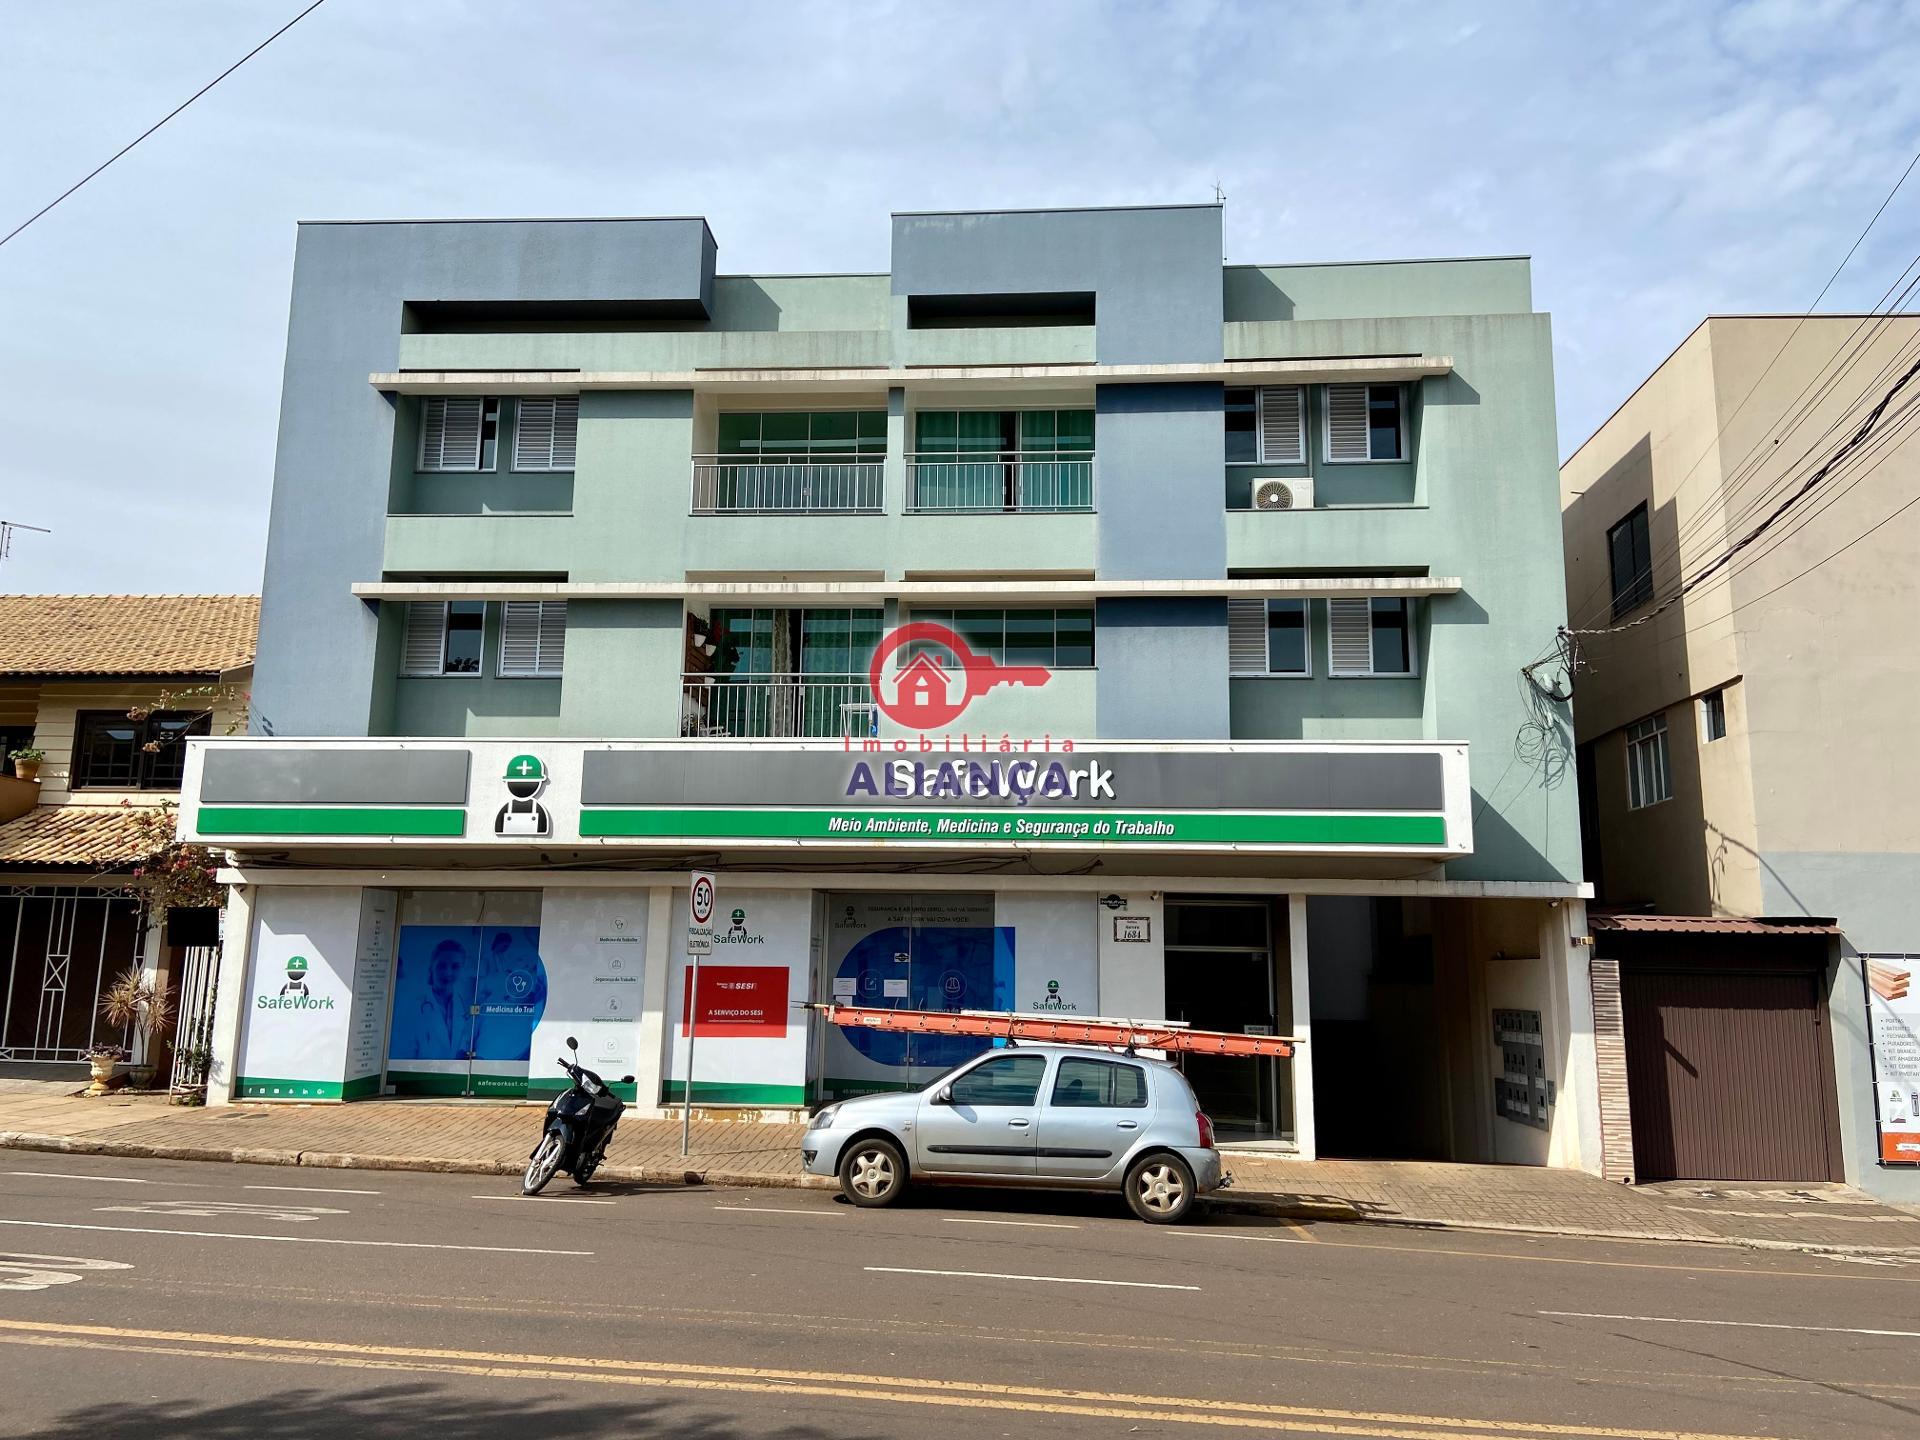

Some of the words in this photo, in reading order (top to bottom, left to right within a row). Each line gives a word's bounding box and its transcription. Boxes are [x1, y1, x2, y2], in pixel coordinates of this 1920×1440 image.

[890, 759, 1117, 800] SafeWork
[828, 817, 862, 832] Meio
[865, 818, 932, 835] Ambiente,
[937, 818, 999, 834] Medicina
[1003, 822, 1011, 833] e
[1016, 819, 1088, 838] Segurança
[1093, 819, 1110, 834] do
[1115, 820, 1175, 836] Trabalho
[696, 887, 710, 907] 50
[713, 934, 764, 944] SafeWork
[735, 982, 754, 990] SESI
[257, 995, 335, 1010] SafeWork
[1032, 1001, 1077, 1011] SafeWork
[486, 1005, 513, 1013] Medicina
[514, 1005, 523, 1013] do
